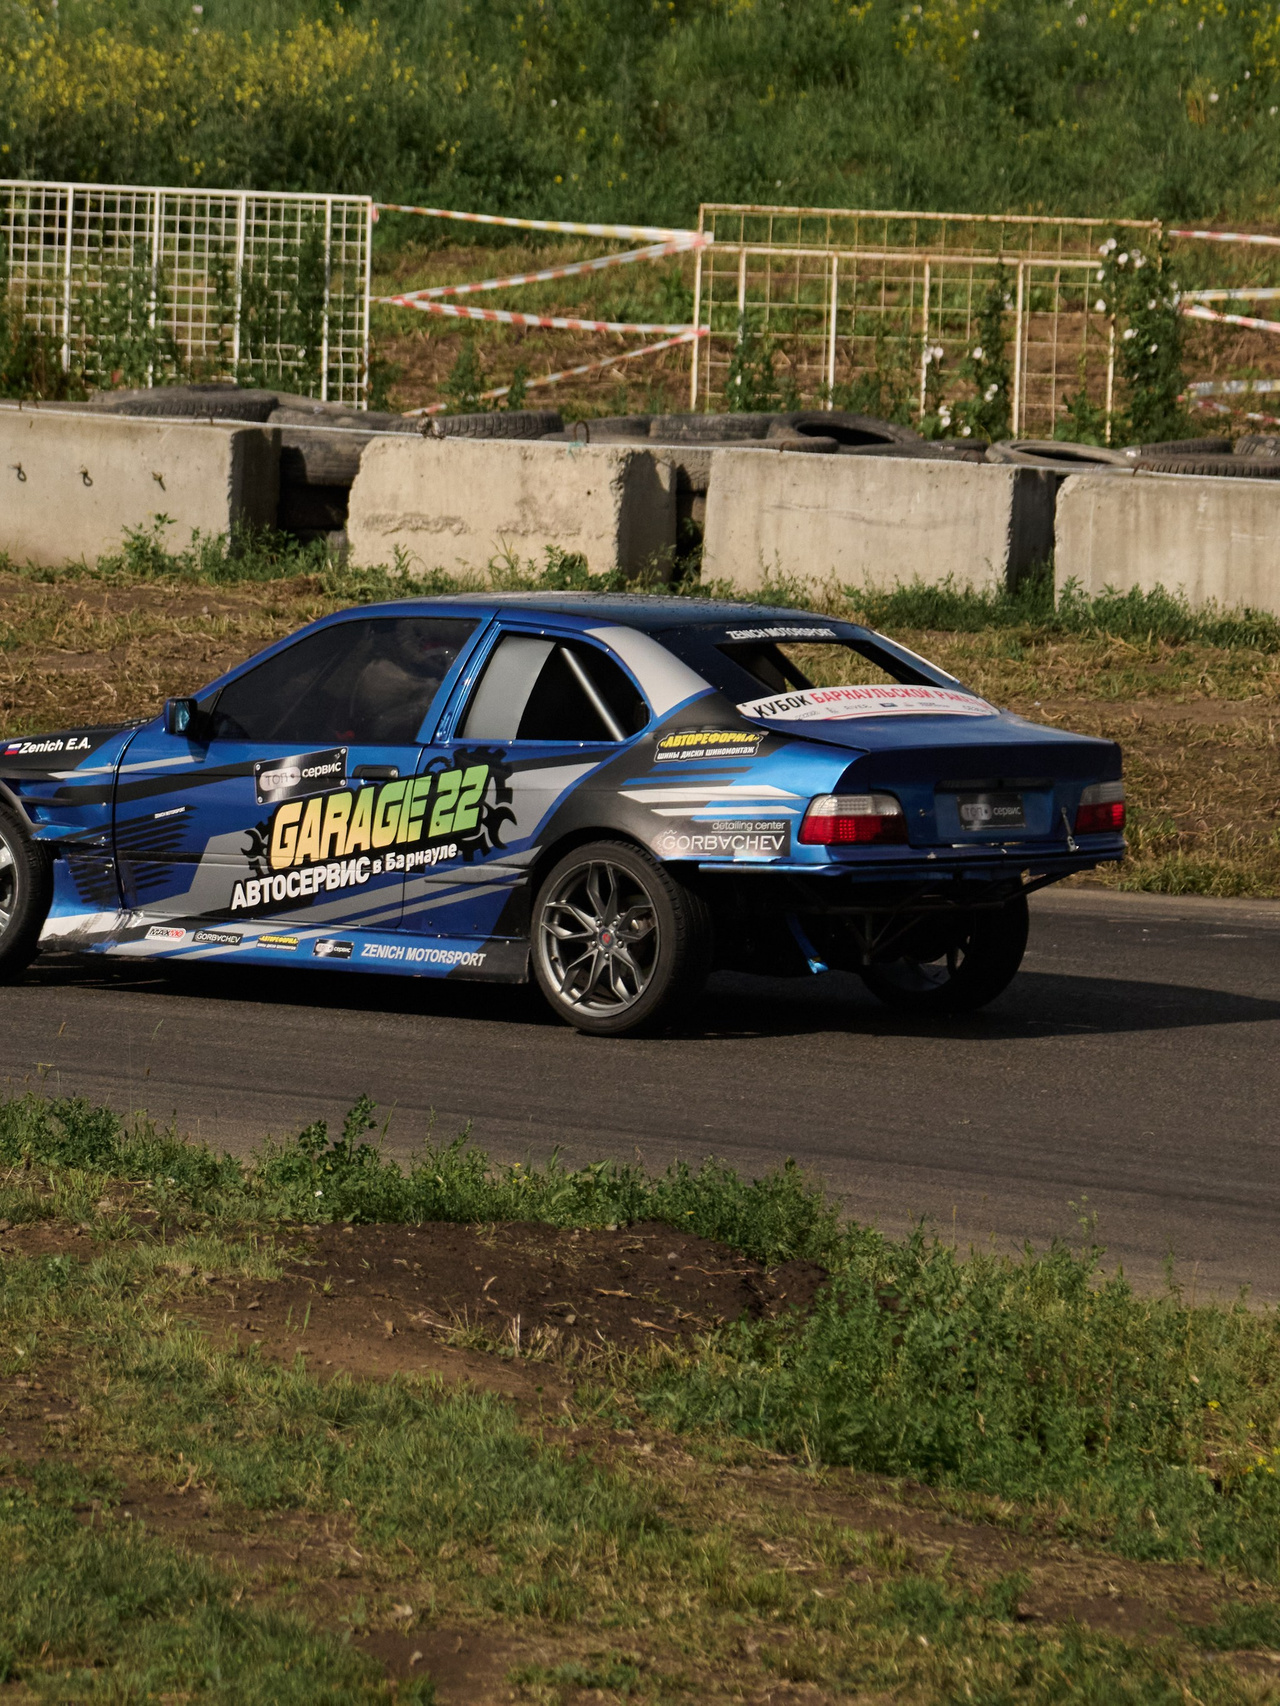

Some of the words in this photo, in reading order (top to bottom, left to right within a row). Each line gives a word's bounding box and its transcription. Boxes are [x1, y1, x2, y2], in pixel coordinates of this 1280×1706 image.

[726, 628, 769, 640] ZENICH
[764, 627, 837, 637] MOTORSPORT
[754, 695, 813, 718] КУБОК
[809, 687, 935, 704] БАРНАУЛЬСКОЙ
[18, 739, 64, 754] Zenich
[65, 737, 92, 751] E.A.
[301, 761, 342, 778] сервис
[270, 775, 432, 870] GARAGE
[428, 764, 489, 838] 22
[993, 806, 1022, 817] сервис
[712, 821, 752, 831] detailing
[754, 821, 785, 830] center
[231, 856, 371, 910] АВТОСЕРВИС
[372, 860, 382, 875] в
[385, 843, 457, 871] Барнауле
[361, 943, 405, 960] ZENICH
[405, 948, 487, 967] MOTORSPORT
